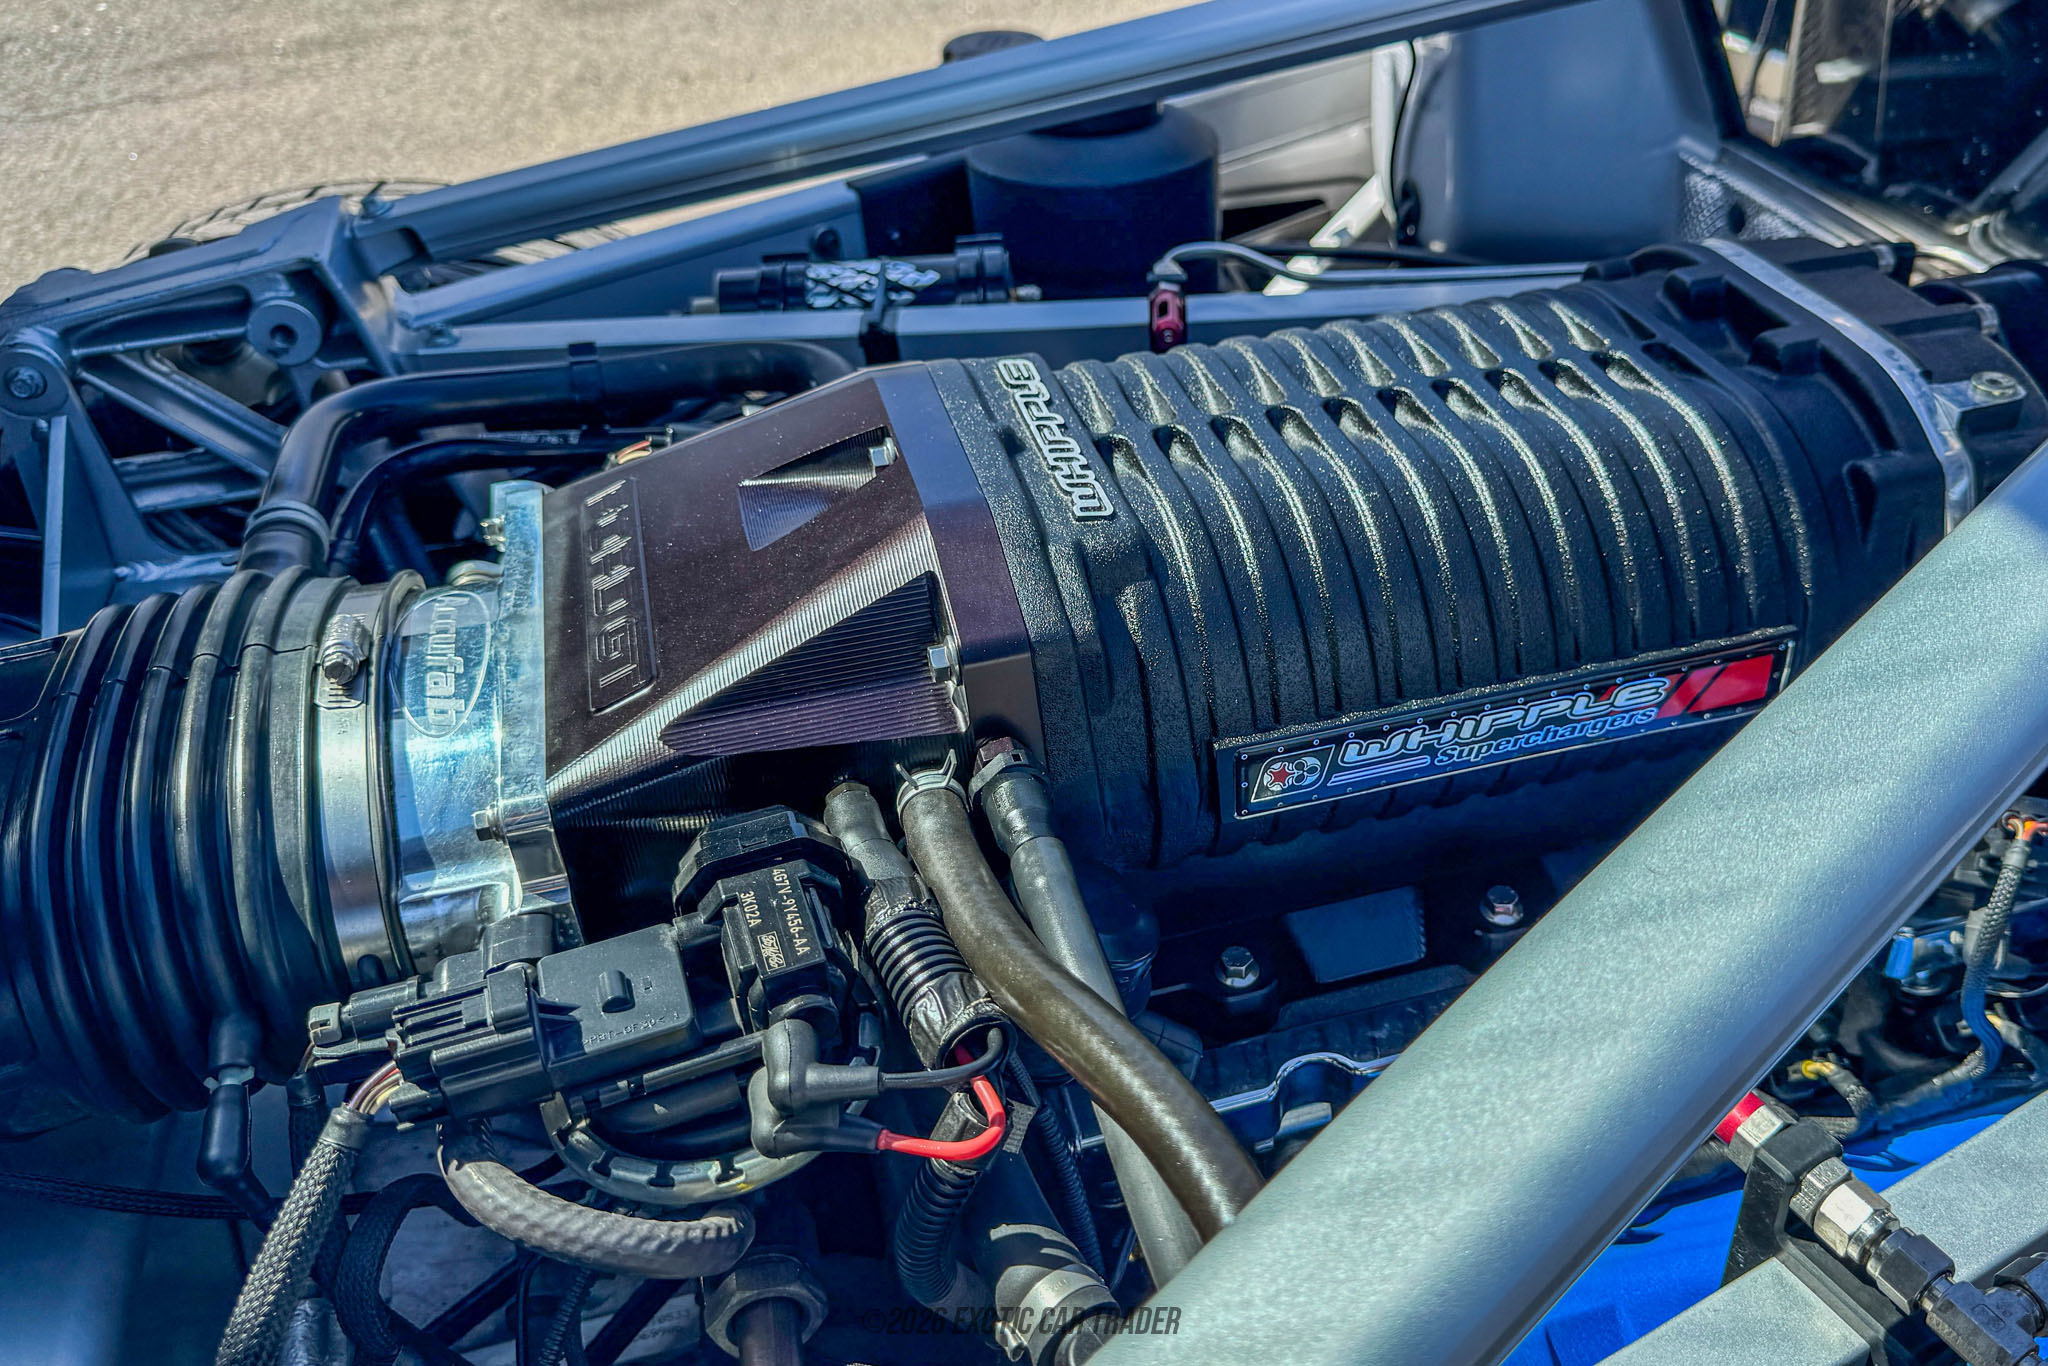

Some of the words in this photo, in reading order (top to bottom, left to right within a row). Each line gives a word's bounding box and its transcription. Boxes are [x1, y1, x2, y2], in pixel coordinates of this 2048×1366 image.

[997, 358, 1114, 517] WHIPPLE
[426, 596, 470, 727] Accufab
[1337, 677, 1671, 767] WHIPPLE
[1433, 707, 1657, 767] Superchargers
[740, 890, 762, 928] 3K02A
[772, 868, 811, 956] 4G7V-9Y456-AA
